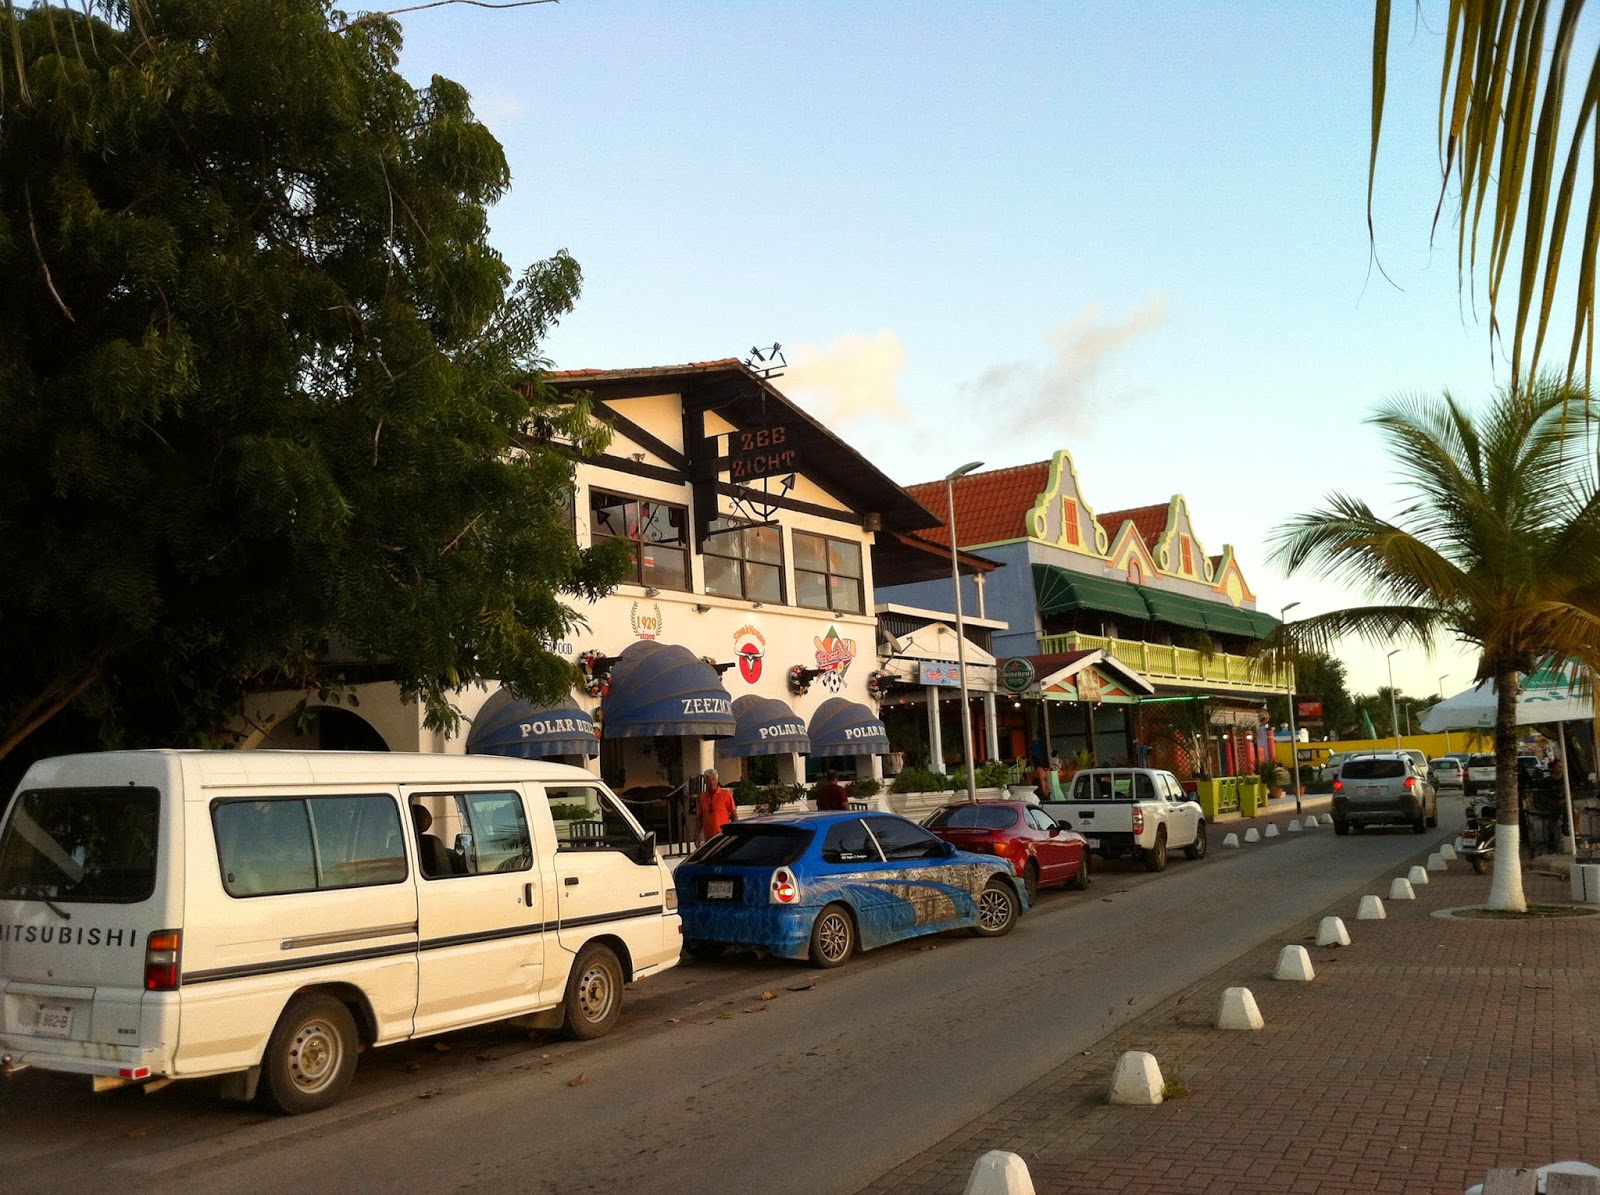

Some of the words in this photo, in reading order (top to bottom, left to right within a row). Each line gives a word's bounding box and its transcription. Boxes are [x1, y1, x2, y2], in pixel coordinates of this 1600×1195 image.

[741, 426, 786, 451] ZEE
[732, 450, 796, 477] ZICHT
[636, 616, 657, 630] 1929
[520, 718, 577, 738] POLAR
[759, 723, 798, 739] POLAR
[844, 725, 880, 739] POLAR
